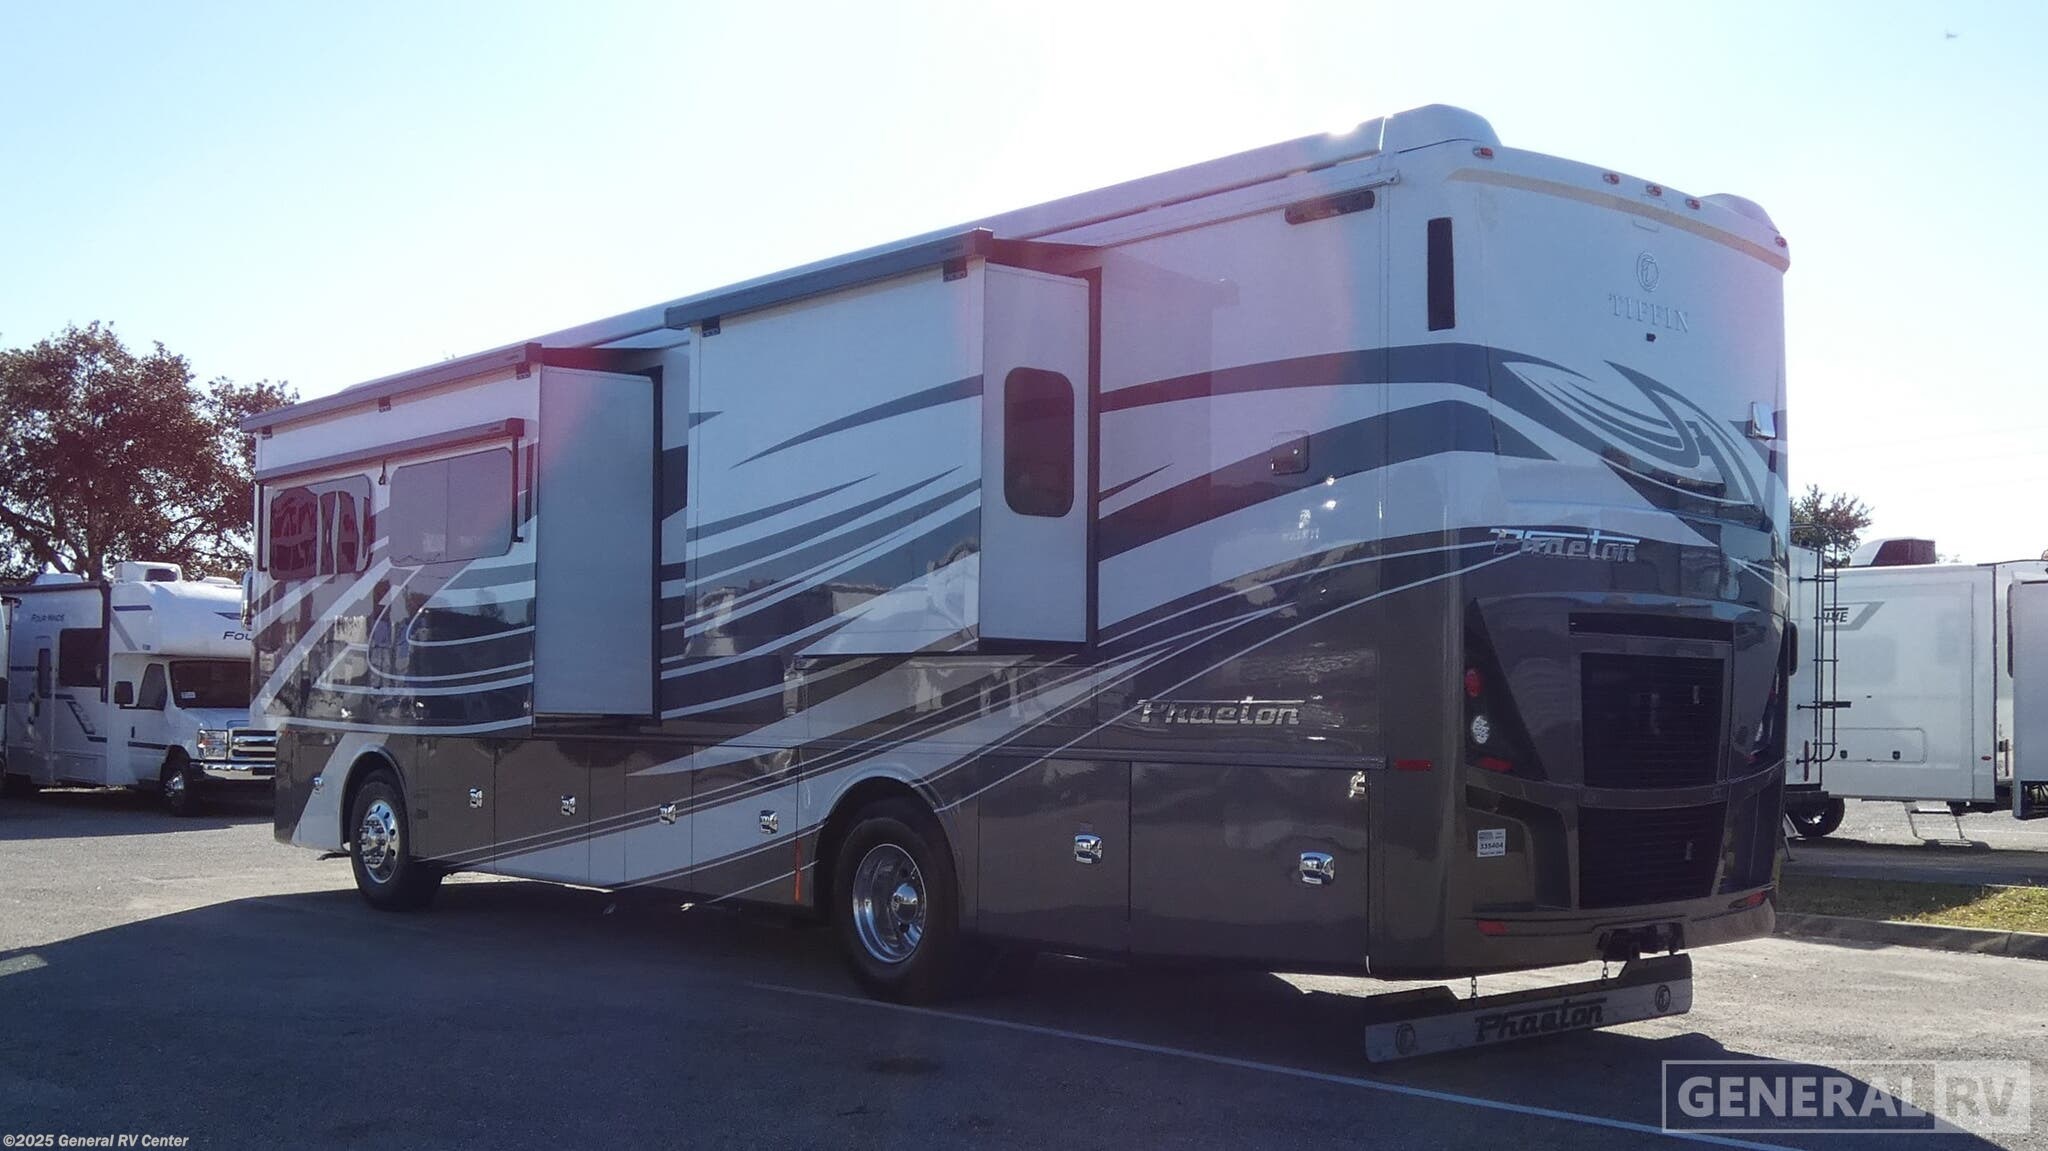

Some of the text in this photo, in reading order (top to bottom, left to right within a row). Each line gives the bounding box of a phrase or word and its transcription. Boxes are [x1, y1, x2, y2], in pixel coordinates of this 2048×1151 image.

[1608, 293, 1689, 333] TIFFIN
[1137, 696, 1306, 725] Phaeton
[1474, 999, 1607, 1042] Phaeton
